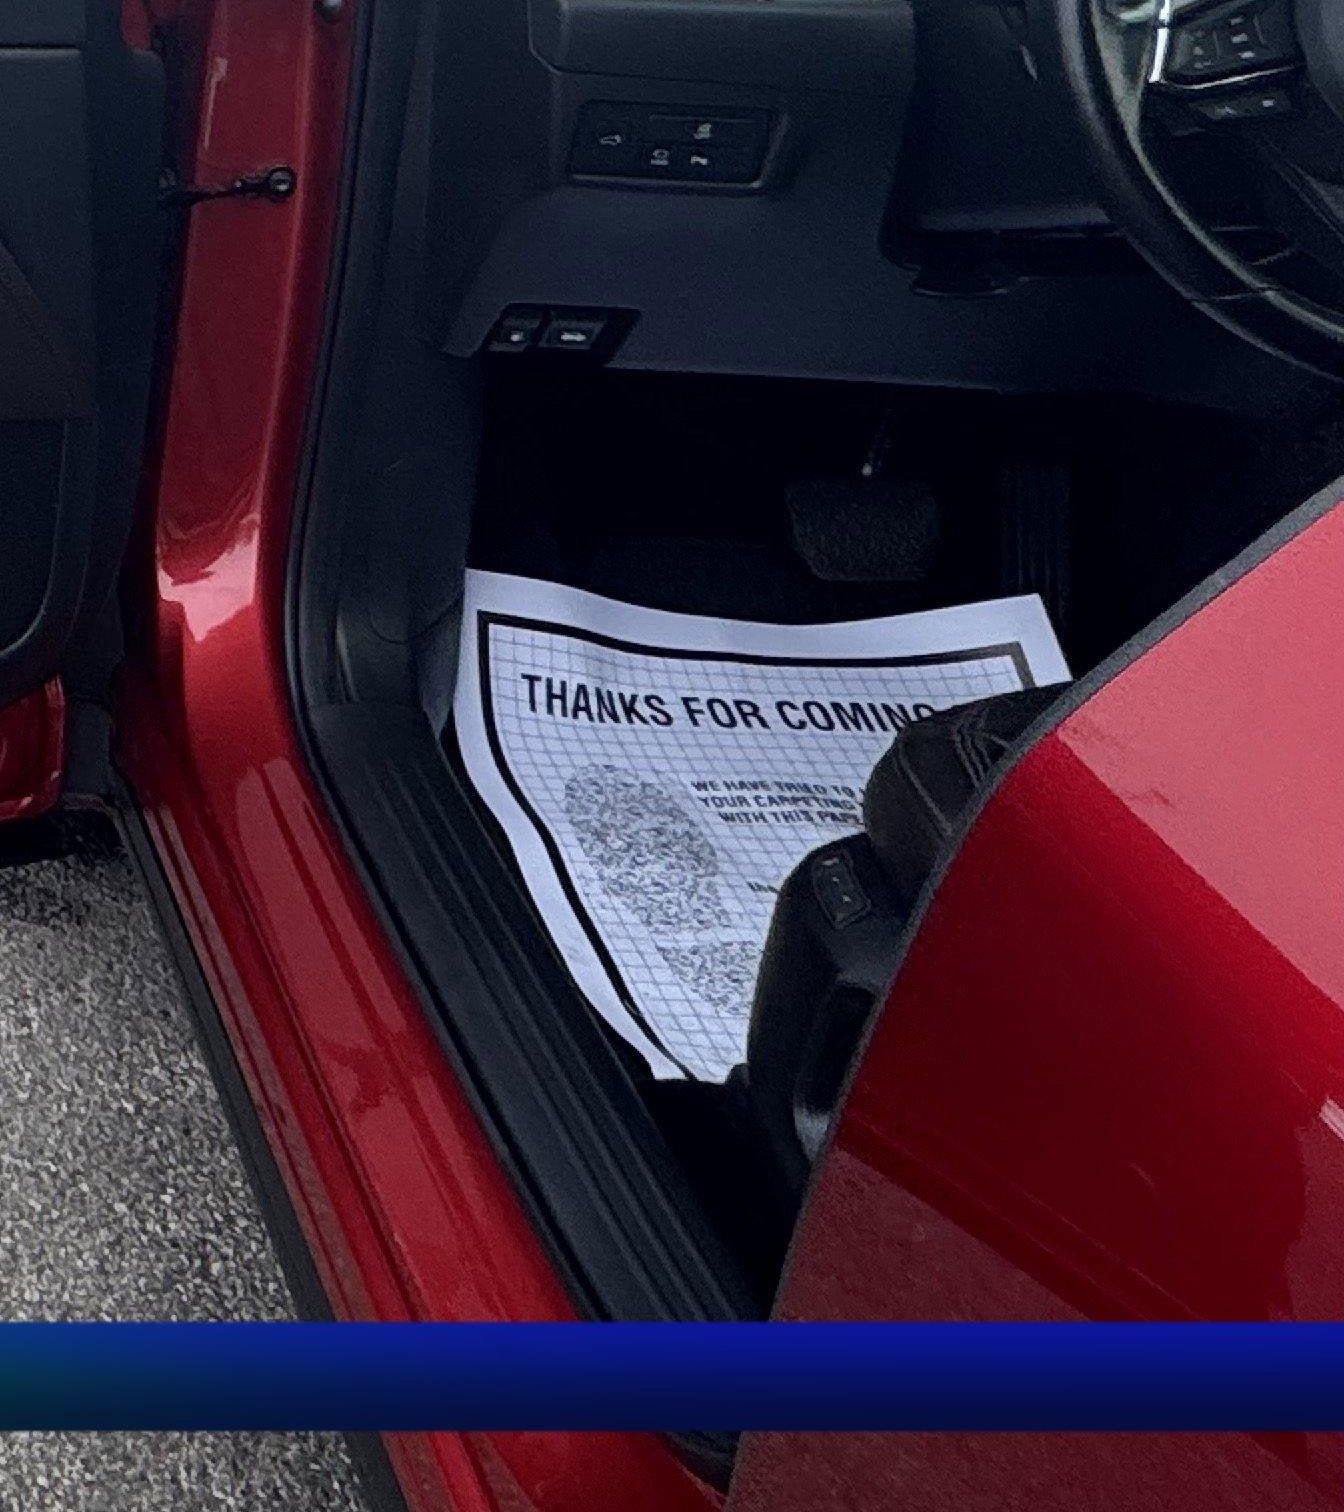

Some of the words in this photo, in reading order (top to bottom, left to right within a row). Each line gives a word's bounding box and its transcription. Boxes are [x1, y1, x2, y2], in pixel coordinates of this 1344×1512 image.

[521, 673, 673, 726] THANKS
[682, 696, 770, 729] FOR
[697, 795, 751, 808] YOUR
